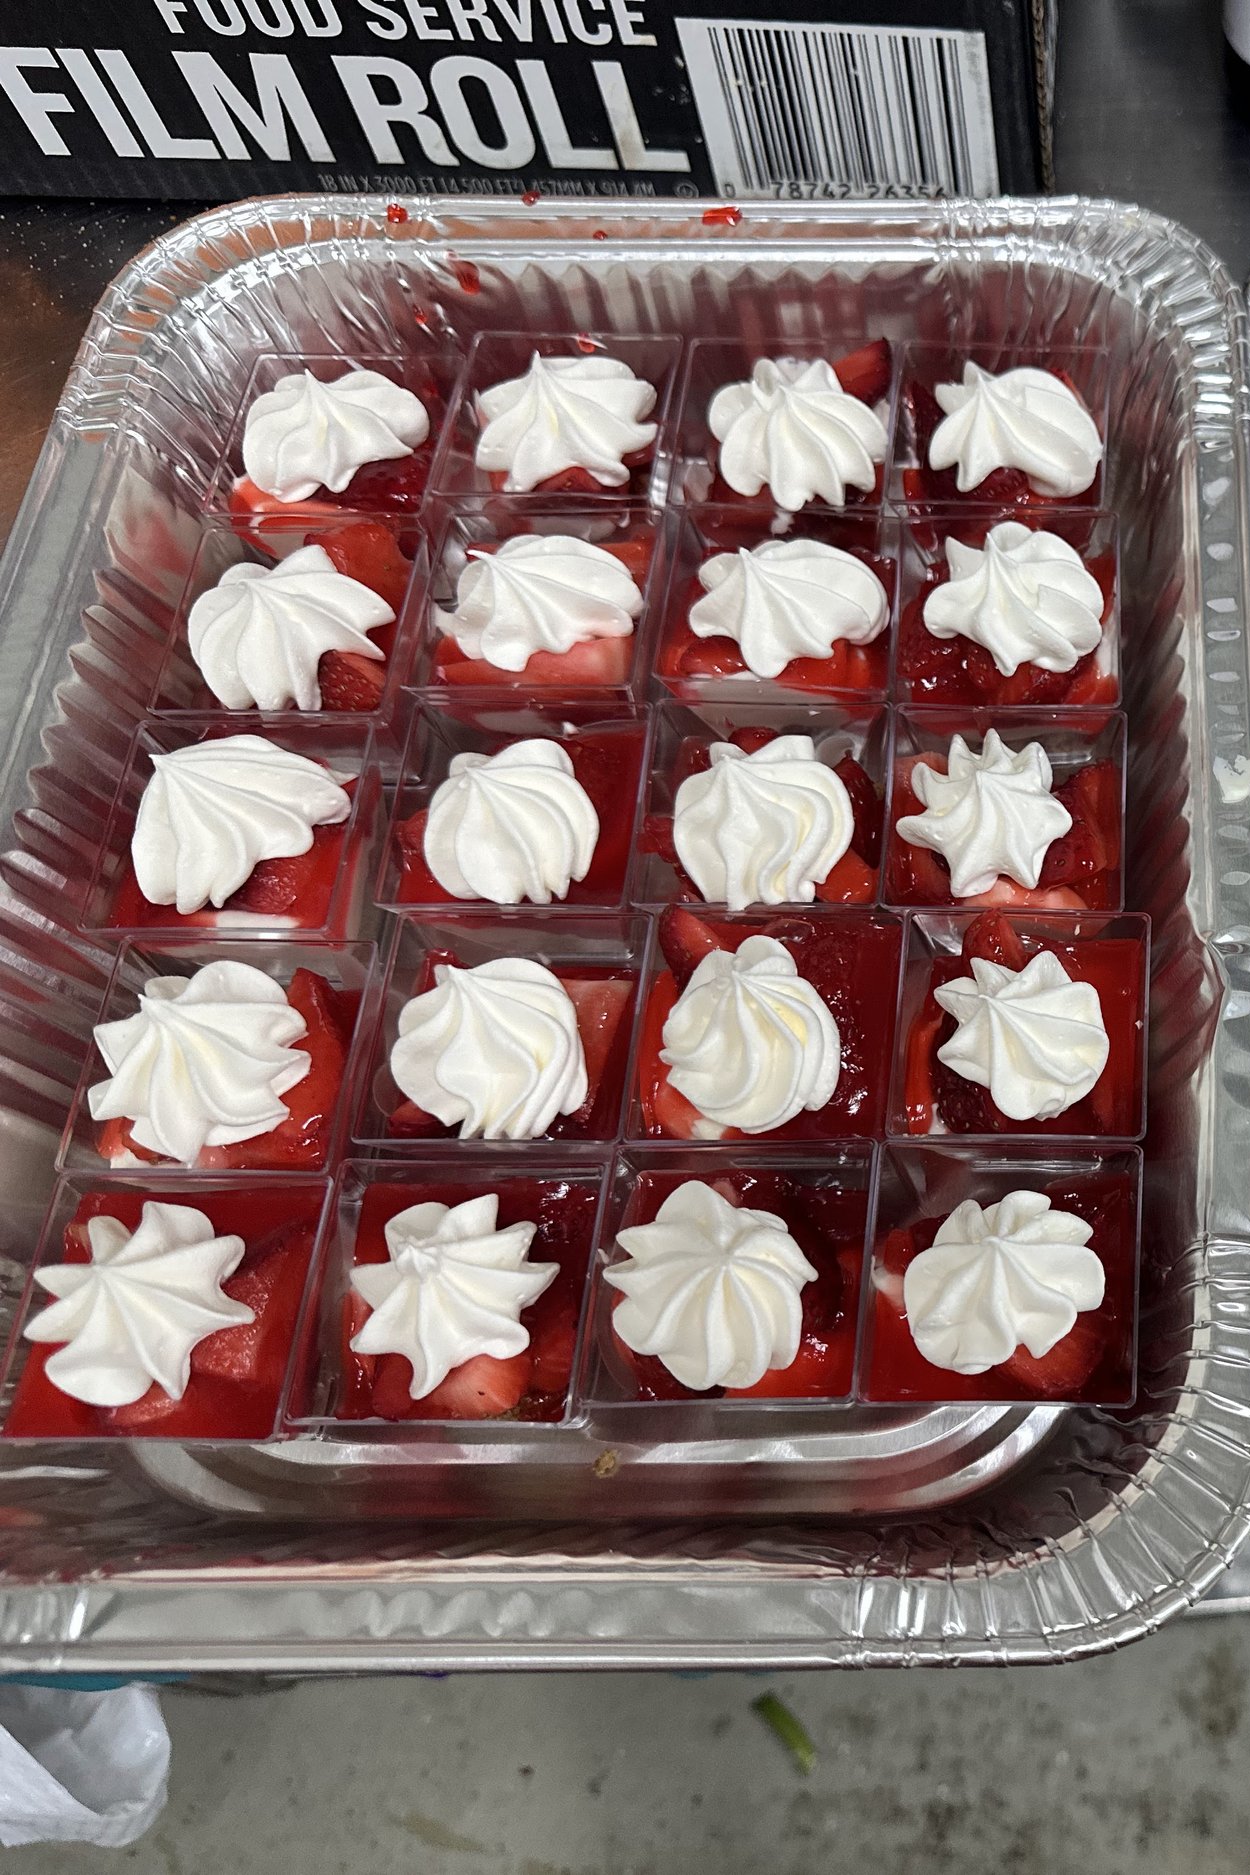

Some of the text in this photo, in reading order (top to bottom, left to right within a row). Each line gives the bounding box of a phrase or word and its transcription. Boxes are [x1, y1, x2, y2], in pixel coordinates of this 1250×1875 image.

[154, 0, 657, 46] FOOD SERVICE
[0, 46, 691, 172] FILM ROLL
[318, 173, 338, 193] 18
[338, 174, 360, 193] IN
[375, 175, 418, 194] 3000
[771, 181, 850, 199] 78742
